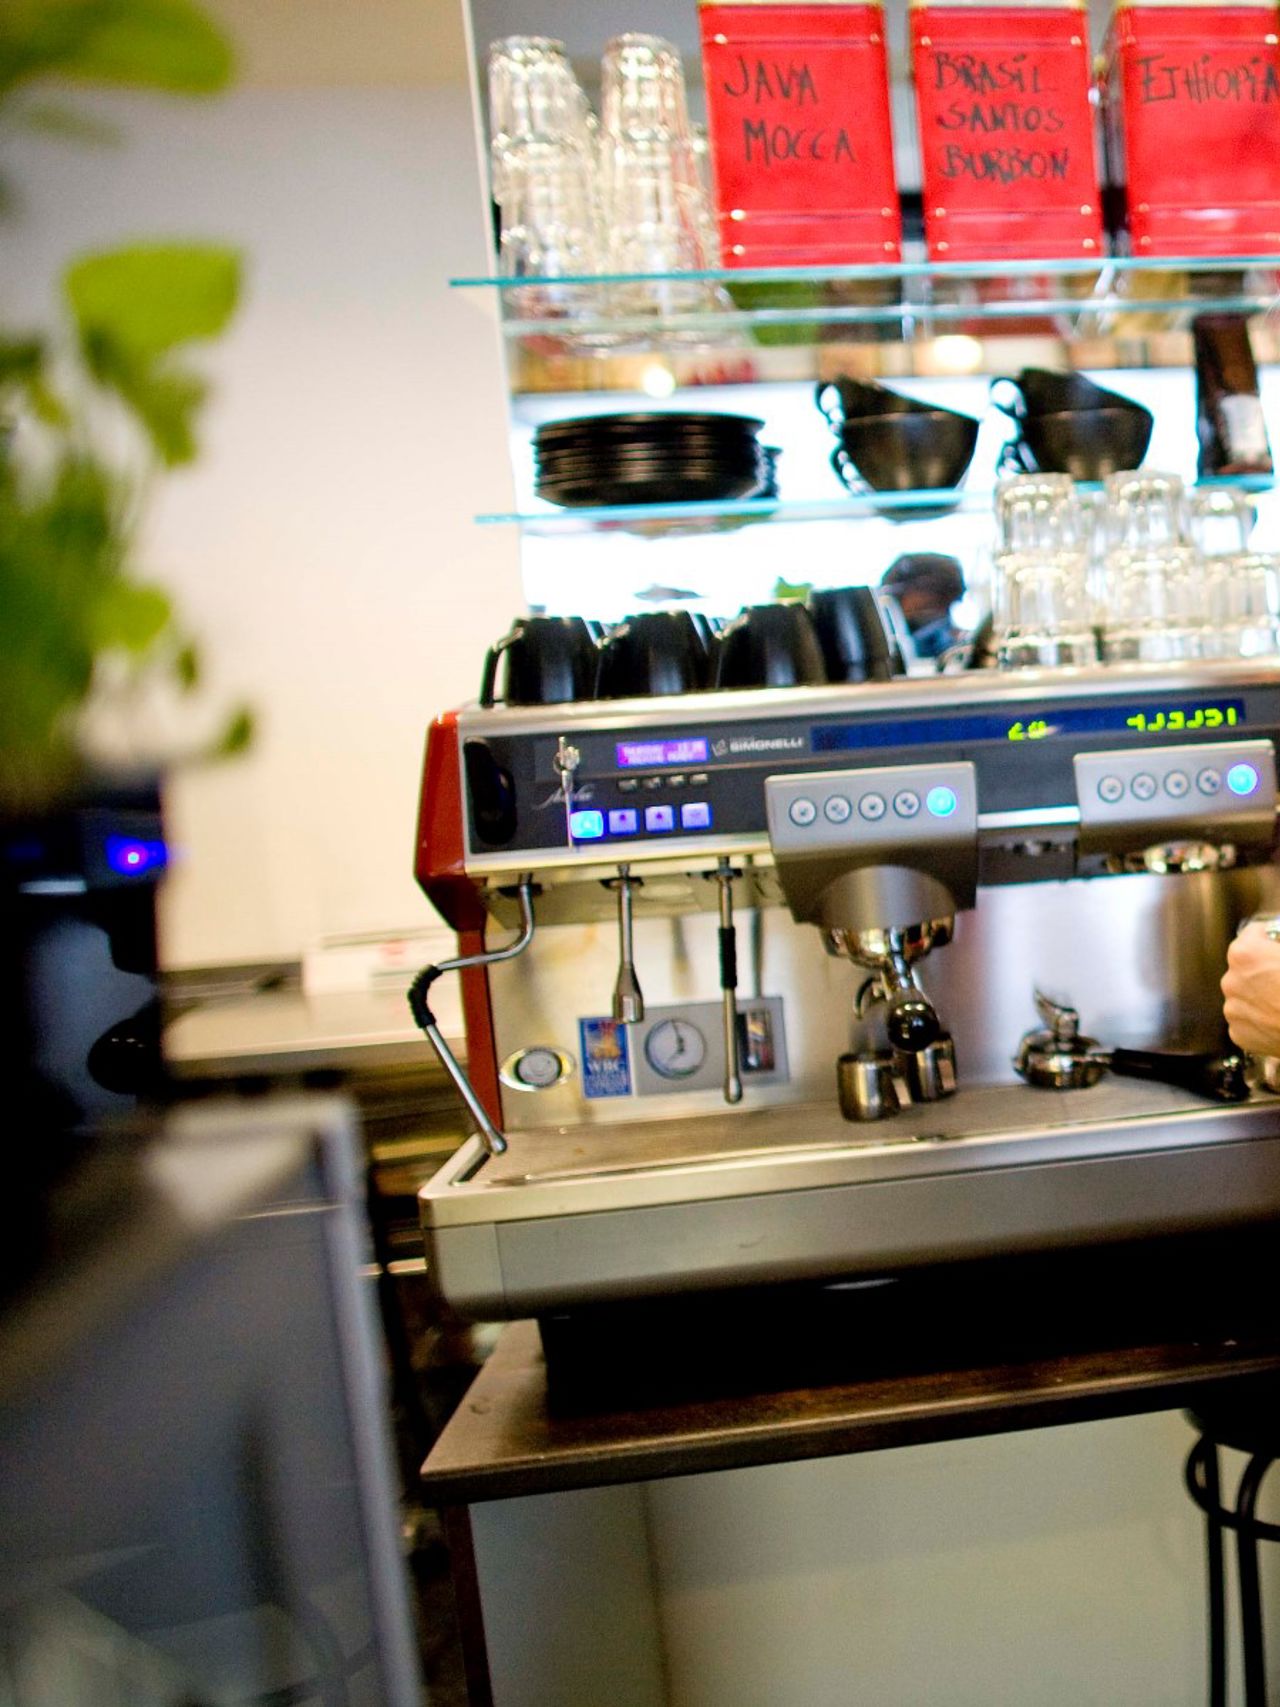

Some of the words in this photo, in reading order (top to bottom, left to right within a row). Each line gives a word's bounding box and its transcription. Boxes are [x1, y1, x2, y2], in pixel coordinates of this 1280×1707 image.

[724, 55, 818, 106] JAVA
[936, 101, 1064, 133] SANTOS
[743, 118, 857, 167] MOCCA
[939, 144, 1068, 185] BURBON
